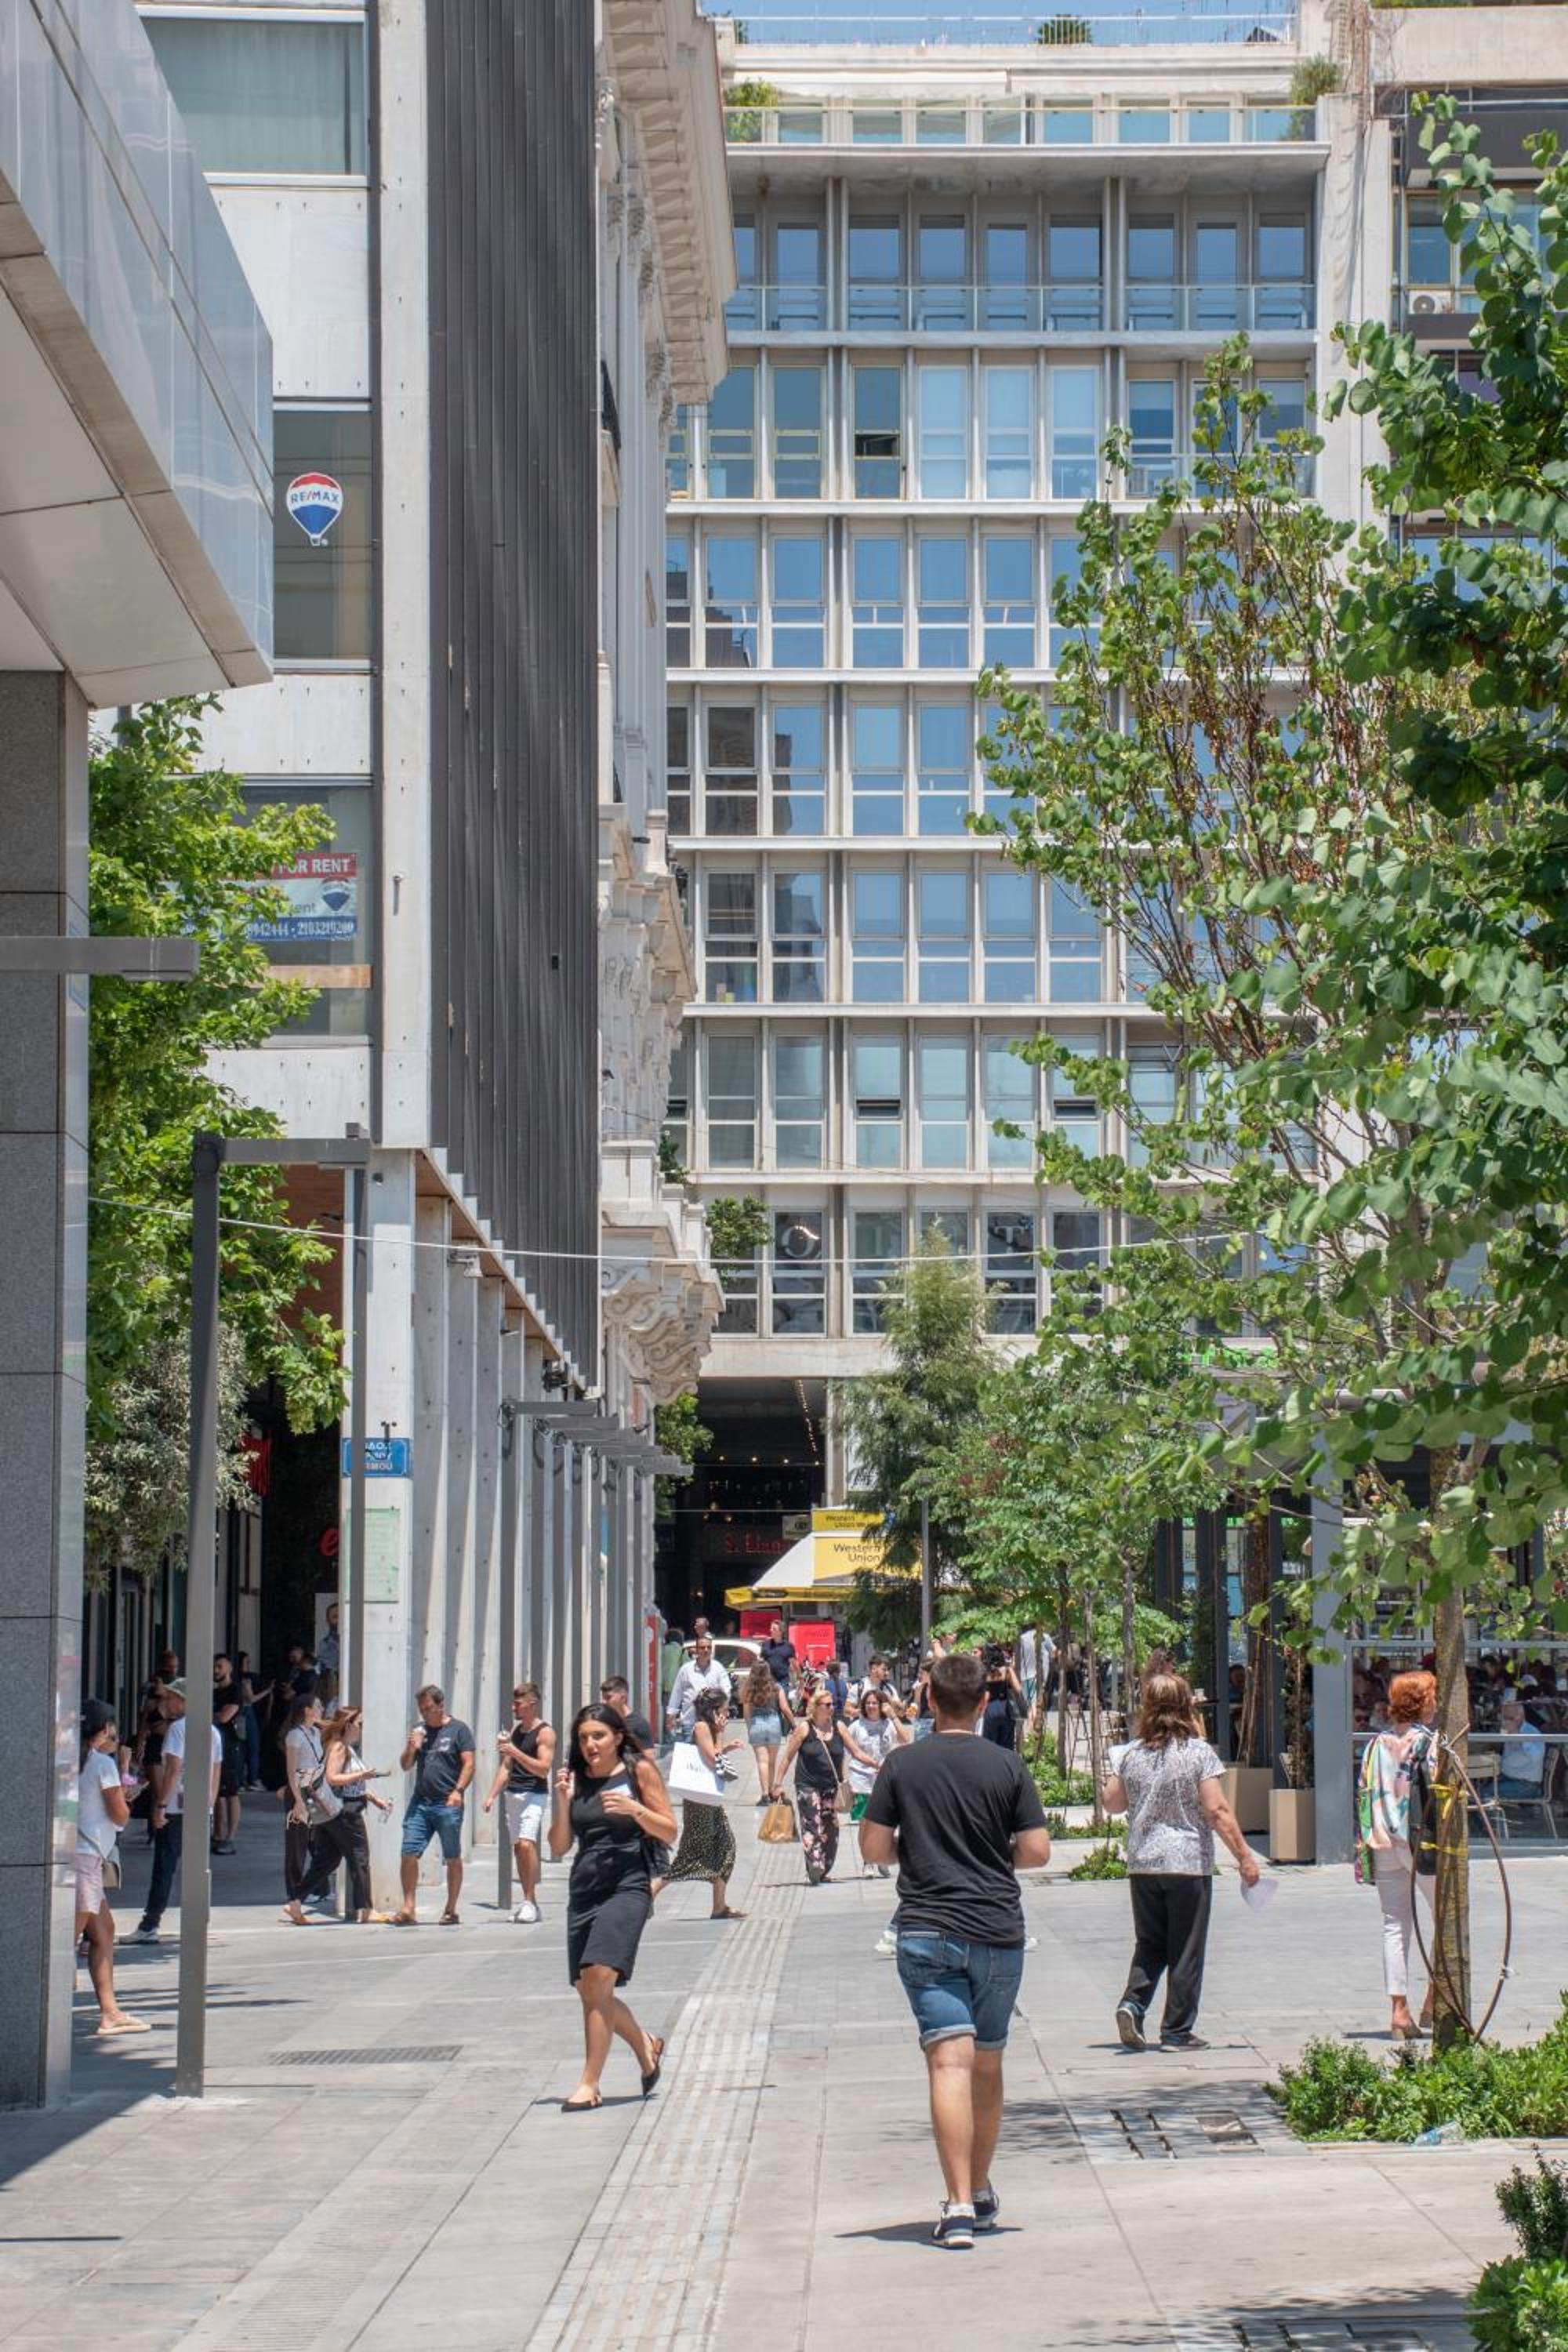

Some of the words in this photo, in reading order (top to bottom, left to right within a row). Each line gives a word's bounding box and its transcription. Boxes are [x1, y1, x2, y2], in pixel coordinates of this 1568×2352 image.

[290, 490, 339, 504] RE/MAX
[312, 858, 350, 873] RENT
[833, 1544, 880, 1553] Western
[848, 1553, 880, 1563] Union
